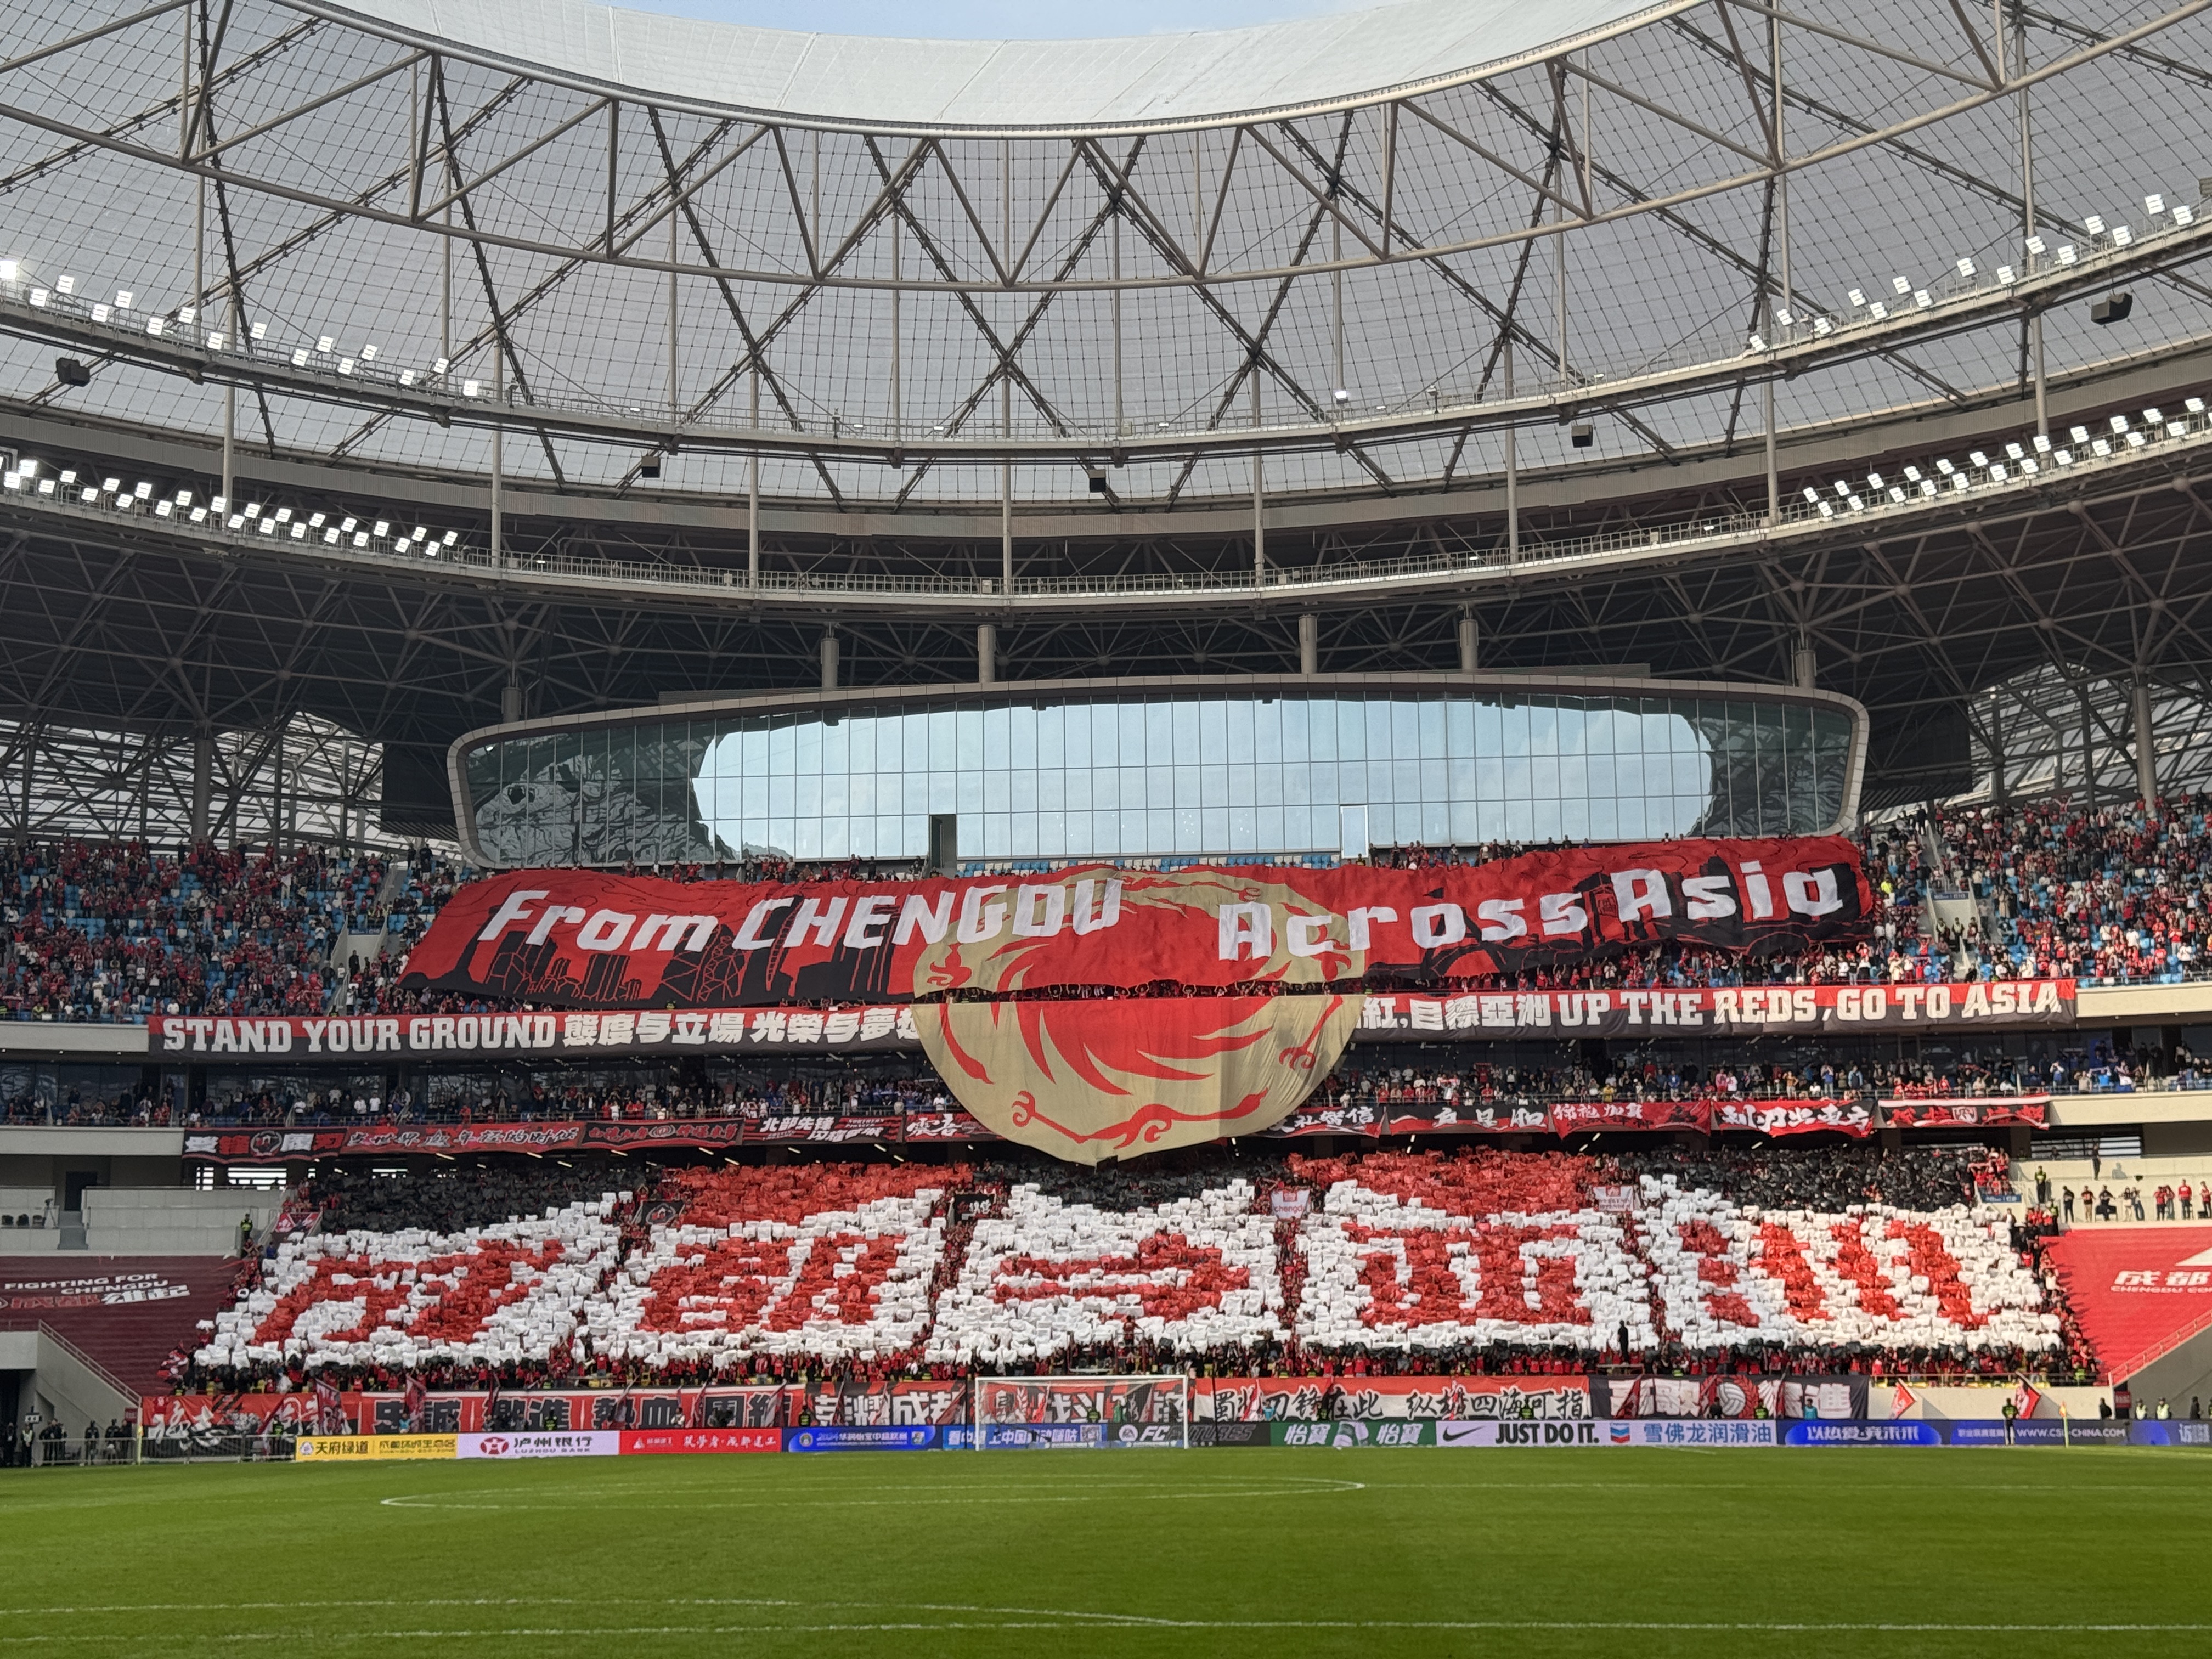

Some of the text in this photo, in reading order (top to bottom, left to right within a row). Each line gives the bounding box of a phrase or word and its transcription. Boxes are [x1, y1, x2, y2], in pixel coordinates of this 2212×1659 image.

[478, 861, 1846, 960] From CHENGDU Across Asia
[1357, 994, 1552, 1031] 紅,目標亞洲
[1557, 991, 1611, 1026] UP
[1620, 991, 1703, 1026] THE
[1895, 985, 1951, 1020] TO
[1961, 981, 2062, 1018] ASIA
[163, 1016, 557, 1052] STAND YOUR GROUND
[4, 1273, 158, 1290] FIGHTING FOR
[61, 1279, 168, 1295] CHENGDU
[1140, 1425, 1170, 1441] FC
[1284, 1423, 1331, 1446] 怡寶
[1376, 1423, 1423, 1446] 怡寶
[1496, 1423, 1599, 1444] JUST DO IT.
[1644, 1423, 1771, 1444] 雪佛龙润滑油
[316, 1440, 368, 1455] 天府绿道
